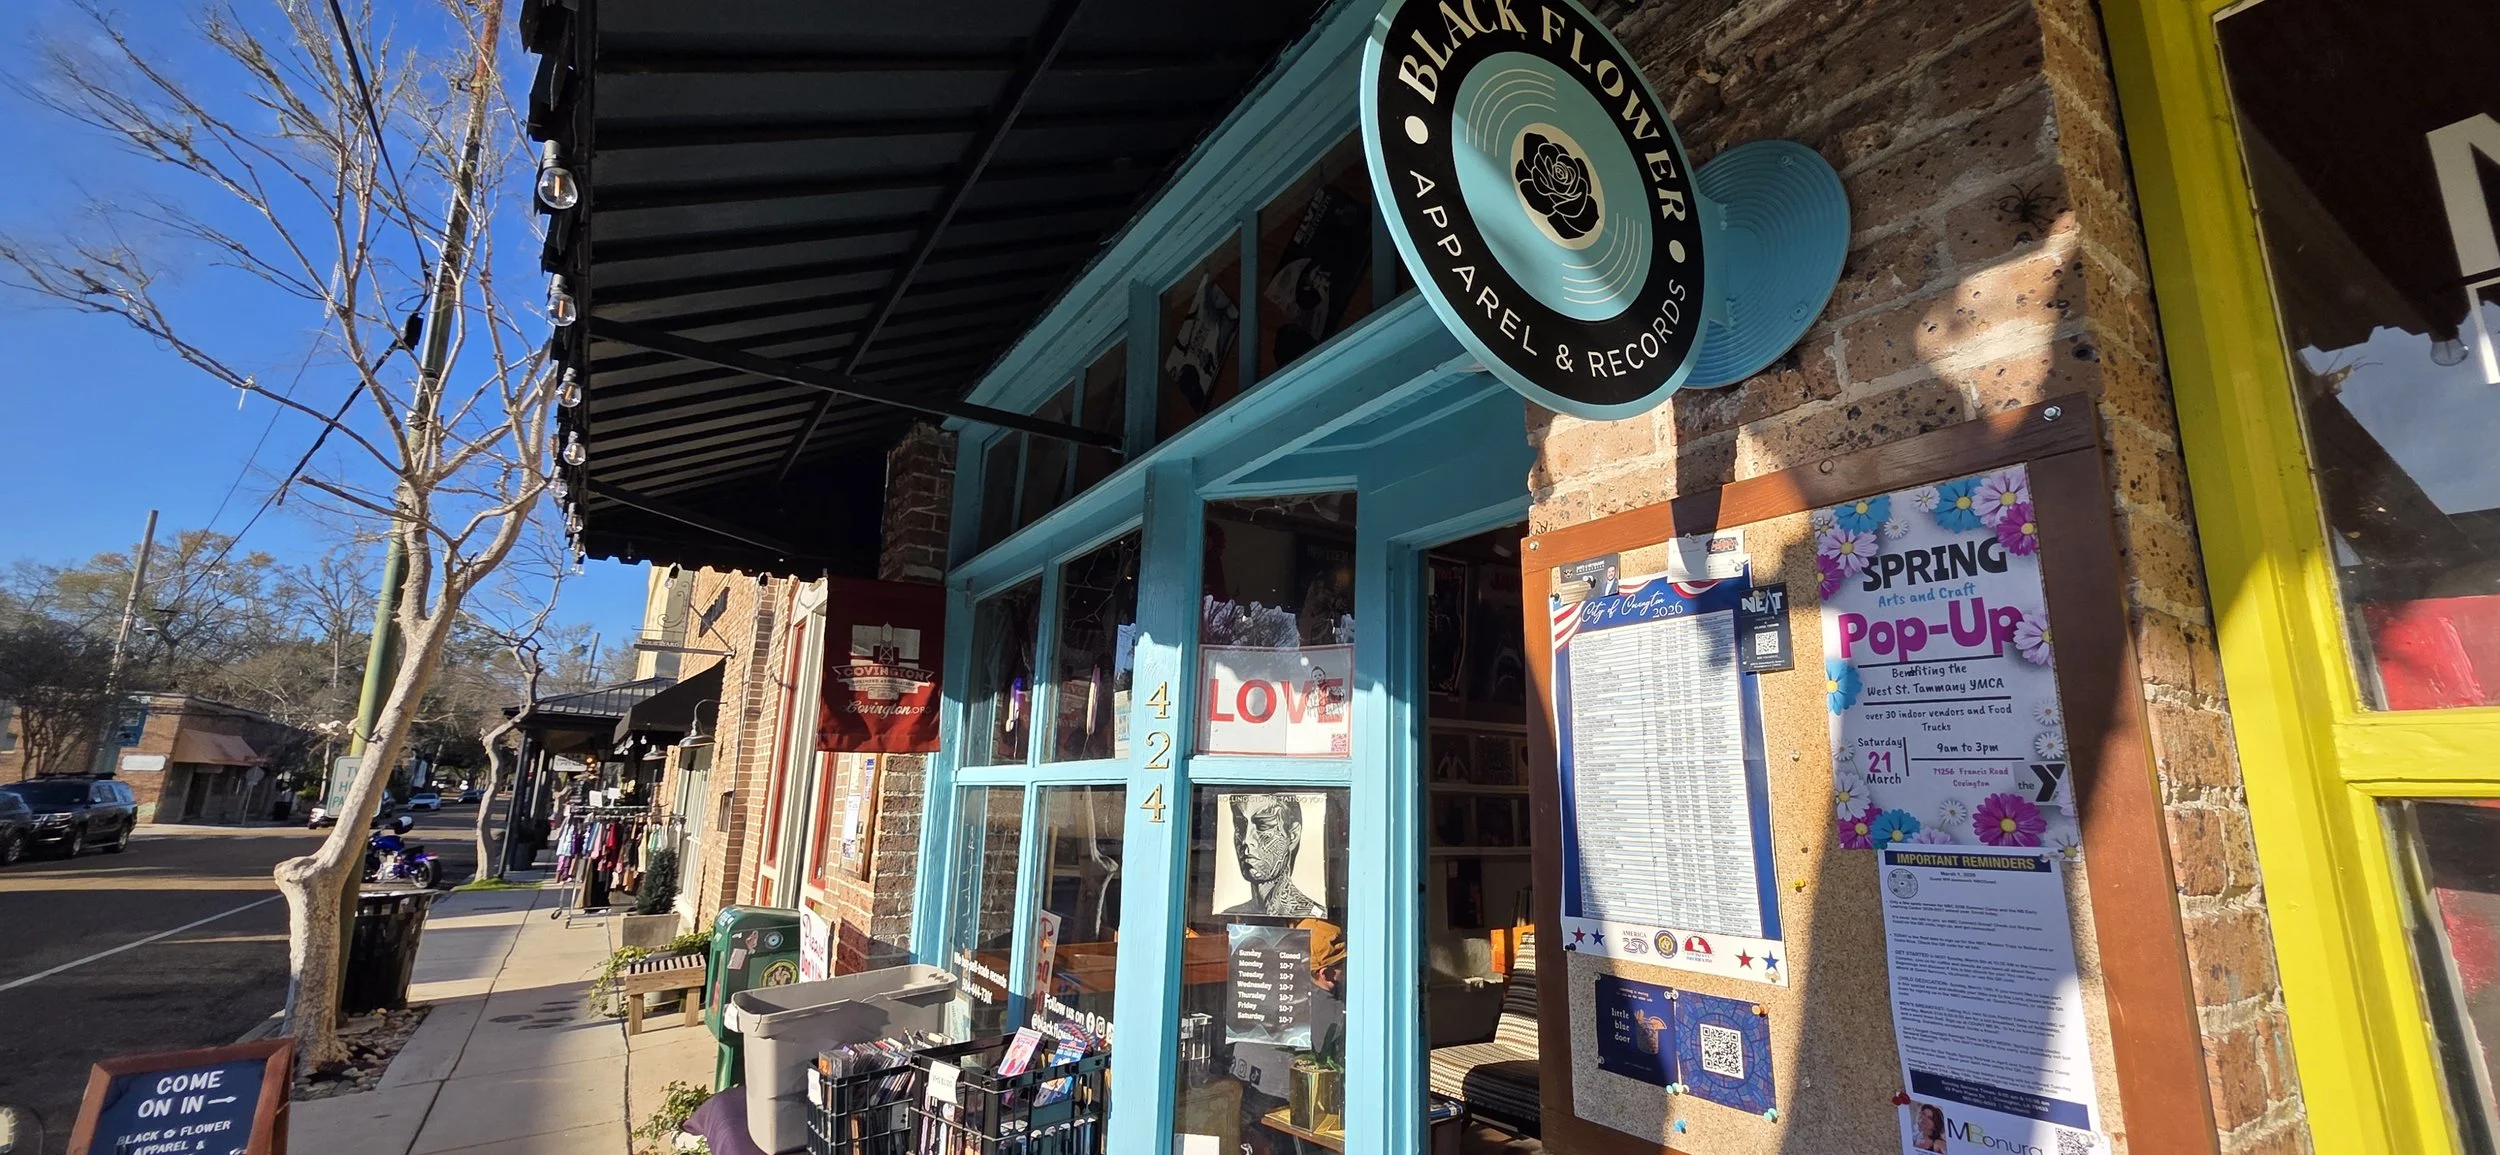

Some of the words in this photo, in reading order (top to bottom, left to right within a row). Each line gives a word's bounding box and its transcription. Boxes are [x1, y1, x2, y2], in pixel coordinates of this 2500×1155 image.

[1398, 0, 1527, 104] BLACK
[1540, 5, 1686, 222] FLOWER
[1409, 170, 1538, 356] APPAREL
[1555, 344, 1574, 373] &
[1587, 279, 1686, 378] RECORDS
[1862, 536, 2008, 592] SPRING
[1878, 594, 1905, 608] Arts
[1911, 588, 1935, 603] and
[1939, 582, 1976, 599] Craft
[1581, 599, 1605, 624] City
[1607, 598, 1620, 618] of
[1652, 603, 1684, 619] 2026
[1838, 597, 2024, 663] Pop-Up
[843, 666, 925, 681] COVINGTON
[1948, 663, 1967, 674] the
[1867, 685, 1892, 697] West
[1895, 683, 1910, 695] St.
[1913, 682, 1966, 694] Tammany
[1969, 677, 2005, 691] YMCA
[1209, 678, 1344, 724] LOVE
[1865, 711, 1884, 720] over
[1885, 710, 1897, 719] 30
[1899, 708, 1926, 718] indoor
[1929, 707, 1965, 718] vendors
[1967, 705, 1986, 715] and
[1988, 703, 2012, 714] Food
[1922, 722, 1951, 732] Trucks
[1857, 737, 1903, 749] Saturday
[1936, 742, 1958, 753] 9am
[1961, 742, 1972, 752] to
[1975, 741, 1999, 754] 3pm
[1139, 681, 1171, 823] 424
[1868, 750, 1892, 773] 21
[1990, 766, 2009, 775] Road
[1866, 772, 1902, 785] March
[2017, 781, 2035, 790] the
[1896, 853, 1958, 867] IMPORTANT
[1962, 855, 2036, 870] REMINDERS
[1622, 930, 1647, 939] AMERICA
[1239, 949, 1262, 958] Sunday
[1279, 951, 1301, 960] Closed
[1239, 960, 1264, 968] Monday
[1279, 962, 1294, 970] 10-7
[1238, 970, 1264, 979] Tuesday
[1237, 981, 1272, 990] Wednesday
[1238, 991, 1266, 1000] Thursday
[1044, 992, 1066, 1017] Follow
[1065, 1006, 1075, 1020] us
[1075, 1010, 1085, 1026] on
[1238, 1001, 1257, 1010] Friday
[1237, 1012, 1265, 1021] Saturday
[1611, 1007, 1630, 1020] little
[1614, 1020, 1630, 1031] blue
[1614, 1032, 1631, 1044] door
[156, 1070, 225, 1095] COME
[137, 1098, 172, 1118] ON
[180, 1095, 205, 1115] IN
[116, 1130, 160, 1146] BLACK
[180, 1120, 232, 1137] FLOWER
[132, 1141, 189, 1155] APPAREL
[196, 1141, 205, 1150] &
